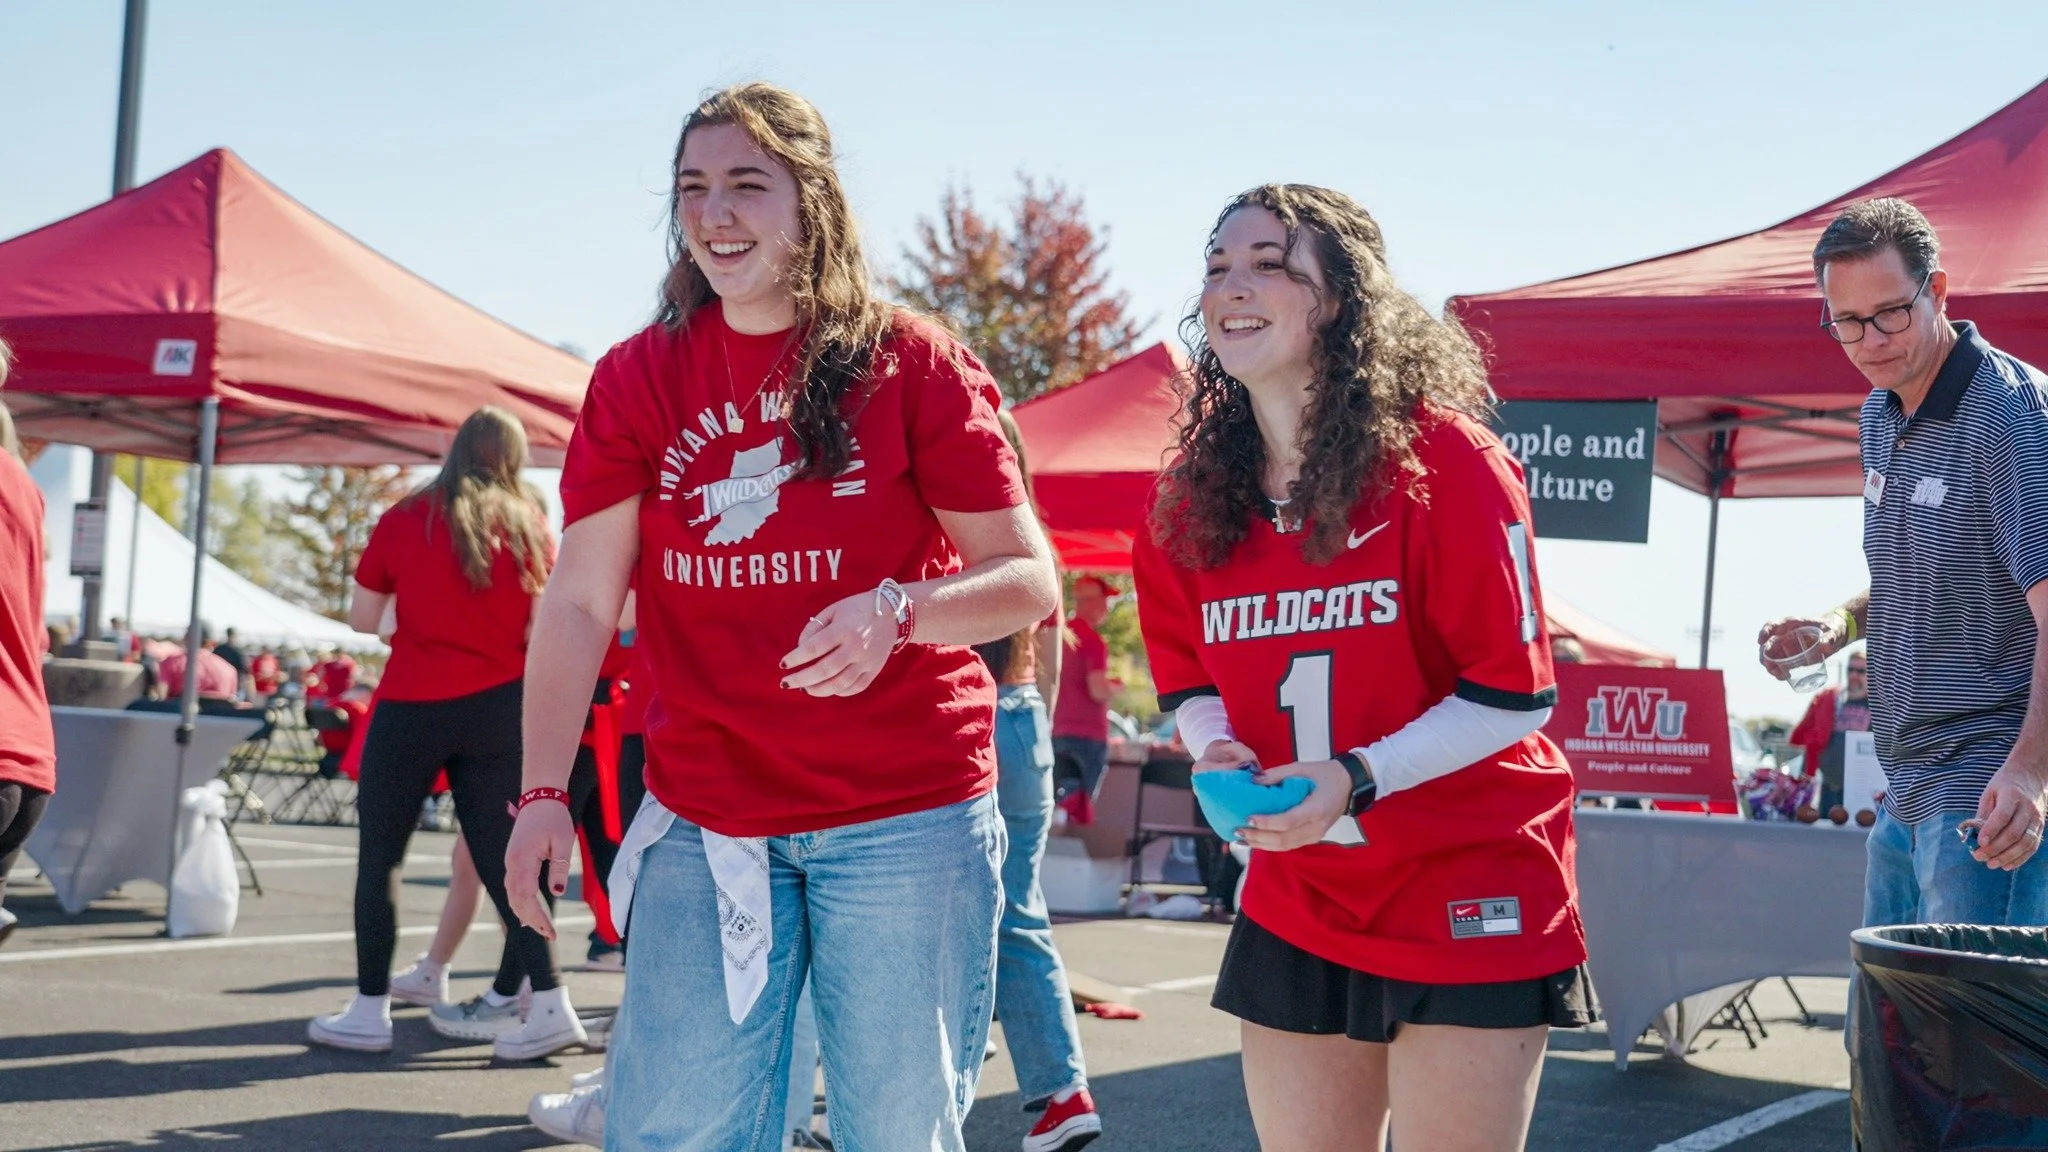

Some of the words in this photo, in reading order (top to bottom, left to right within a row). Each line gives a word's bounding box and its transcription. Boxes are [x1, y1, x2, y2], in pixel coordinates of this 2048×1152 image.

[1502, 424, 1573, 464] ople
[1583, 427, 1645, 460] and
[1529, 467, 1614, 502] lture
[663, 548, 842, 588] UNIVERSITY
[1201, 578, 1399, 645] WILDCATS
[1585, 685, 1687, 741] IWU
[1565, 738, 1605, 752] INDIANA
[1605, 739, 1654, 755] WESLEYAN
[1656, 742, 1710, 757] UNIVERSITY
[1588, 760, 1624, 774] People
[1627, 762, 1647, 773] and
[1650, 763, 1692, 775] Culture
[1493, 904, 1506, 916] M
